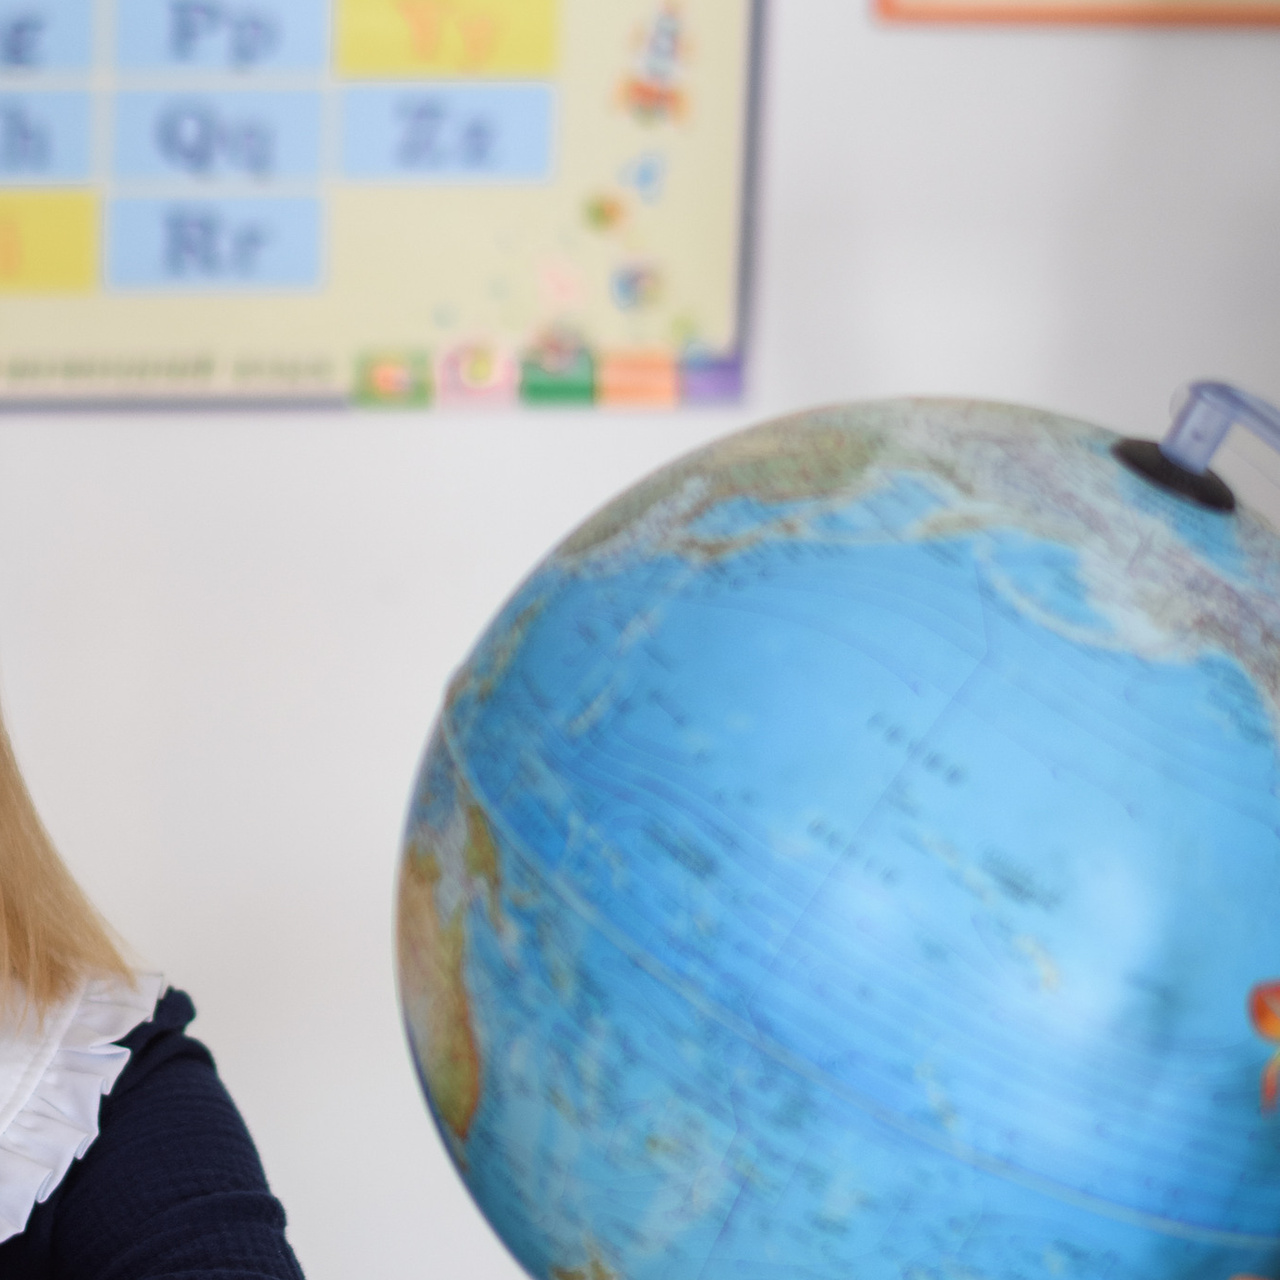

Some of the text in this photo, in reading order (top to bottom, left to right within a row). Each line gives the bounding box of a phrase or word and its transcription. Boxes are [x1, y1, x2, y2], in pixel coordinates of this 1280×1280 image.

[156, 104, 276, 183] Qq
[394, 102, 496, 174] Zz
[163, 213, 272, 282] Rr
